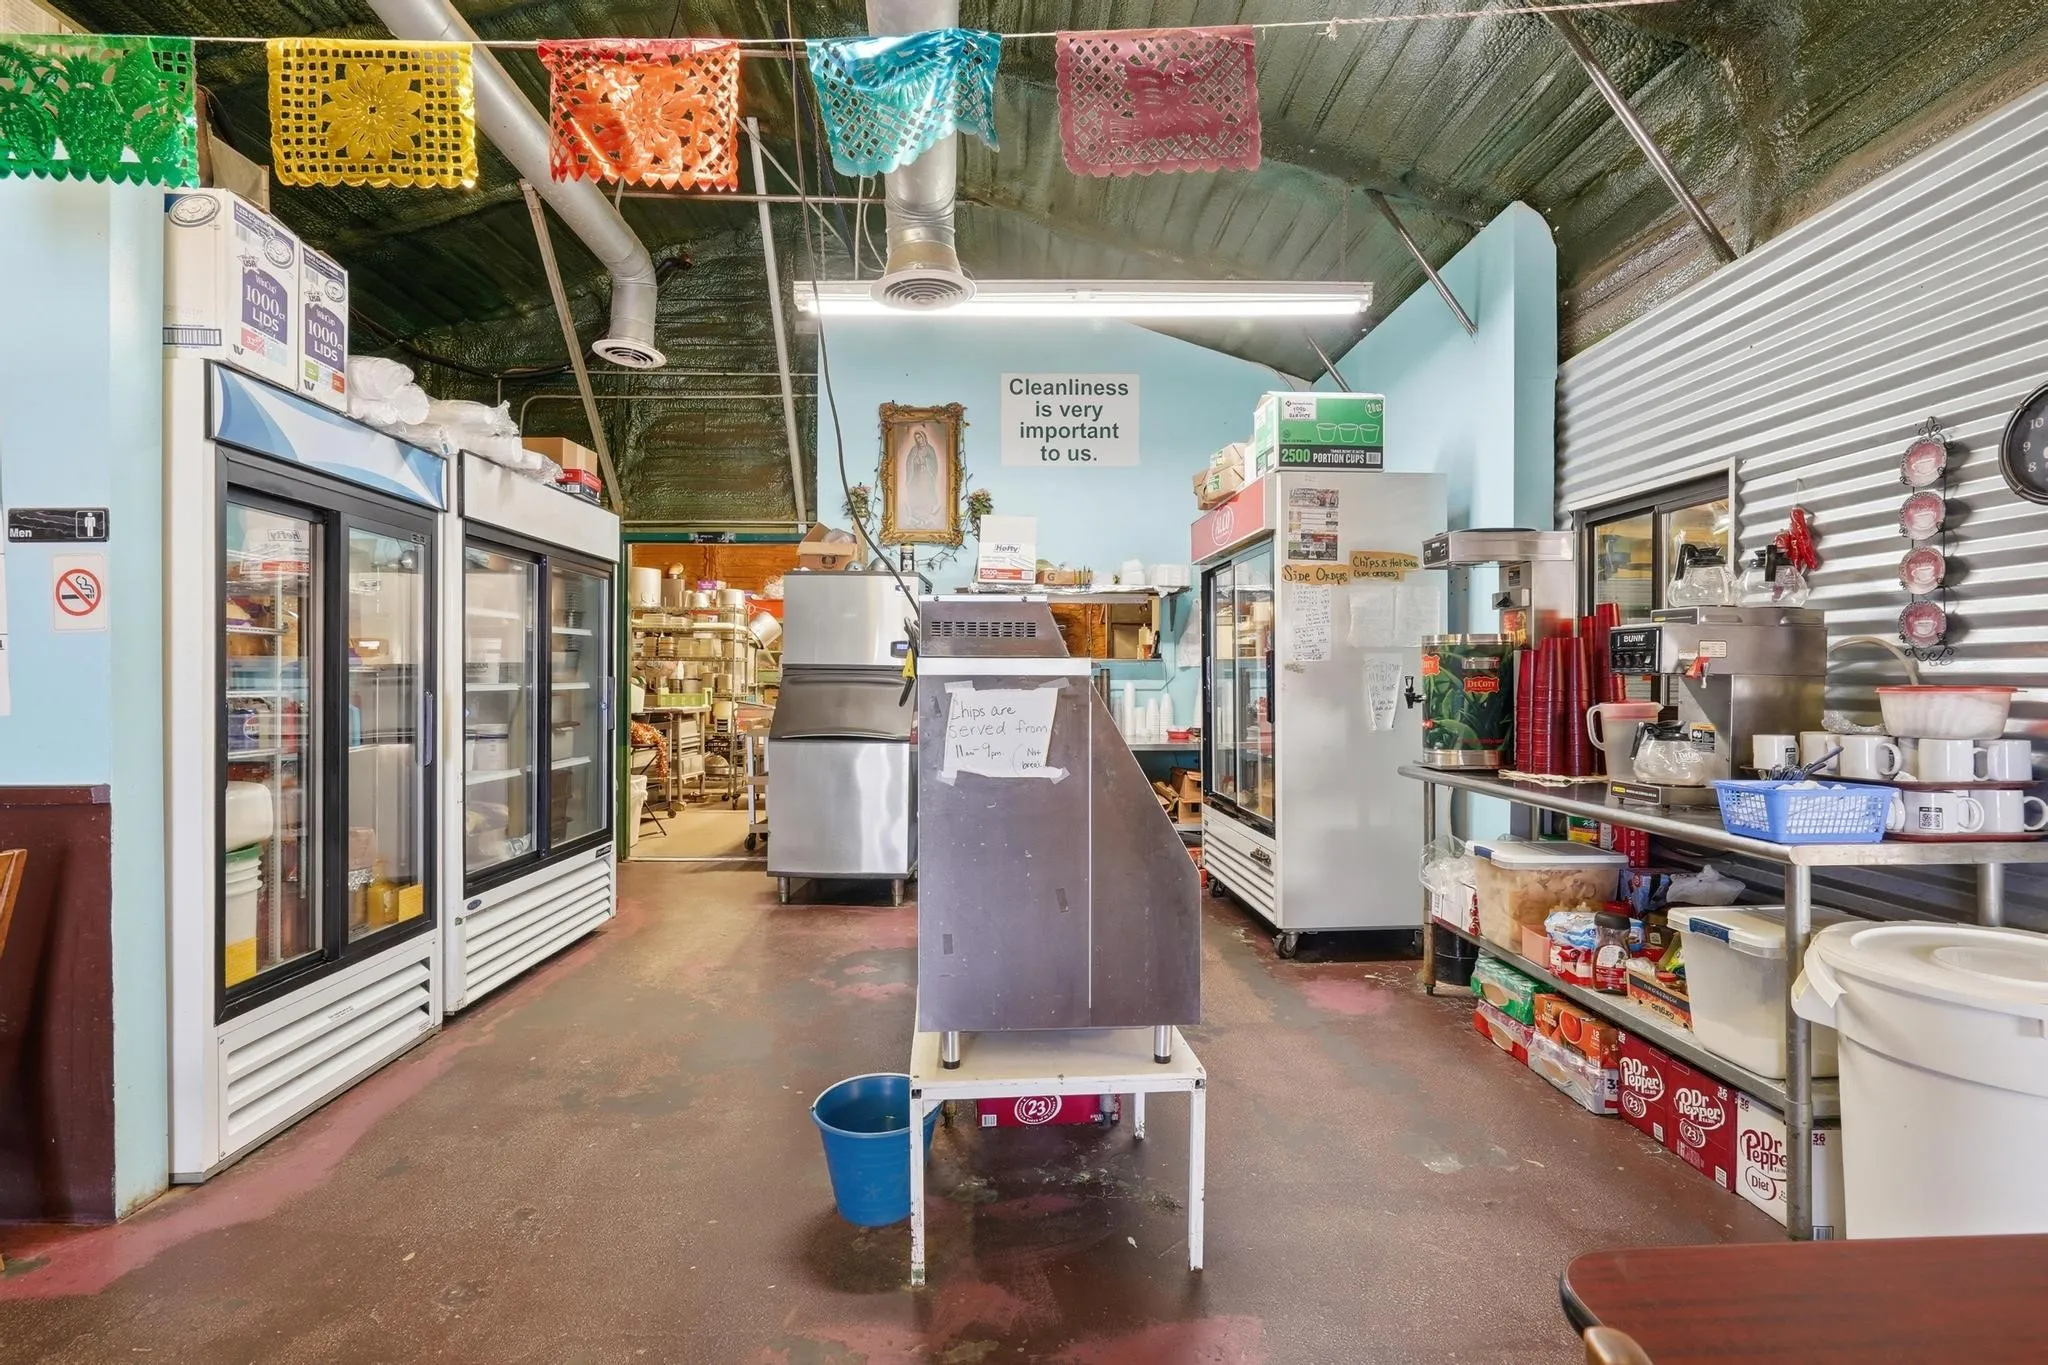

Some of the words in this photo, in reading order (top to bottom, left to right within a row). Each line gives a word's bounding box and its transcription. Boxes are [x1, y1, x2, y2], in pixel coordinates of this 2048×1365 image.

[252, 306, 280, 332] LIDS
[314, 340, 339, 362] LIDS
[1009, 378, 1129, 396] Cleanliness
[1035, 400, 1052, 417] is
[1059, 404, 1103, 422] very
[1020, 421, 1119, 443] important
[2030, 417, 2044, 429] 10
[1040, 445, 1060, 461] to
[1068, 447, 1097, 461] us.
[2023, 441, 2031, 452] 9
[1281, 448, 1311, 463] 2500
[1312, 453, 1345, 464] PORTION
[1345, 453, 1366, 464] CUPS
[2028, 461, 2037, 473] 8
[9, 528, 33, 539] Men
[1623, 634, 1646, 643] BUNN
[951, 700, 986, 721] Chips
[991, 706, 1016, 717] are
[1015, 719, 1049, 737] from
[1620, 1057, 1660, 1094] Pepper
[1633, 1058, 1649, 1077] Dr
[1675, 1087, 1721, 1121] Pepper
[1691, 1088, 1710, 1107] Dr
[1028, 1099, 1047, 1116] 23
[1760, 1131, 1783, 1154] Dr
[1812, 1132, 1826, 1144] 36
[1752, 1175, 1770, 1191] Diet
